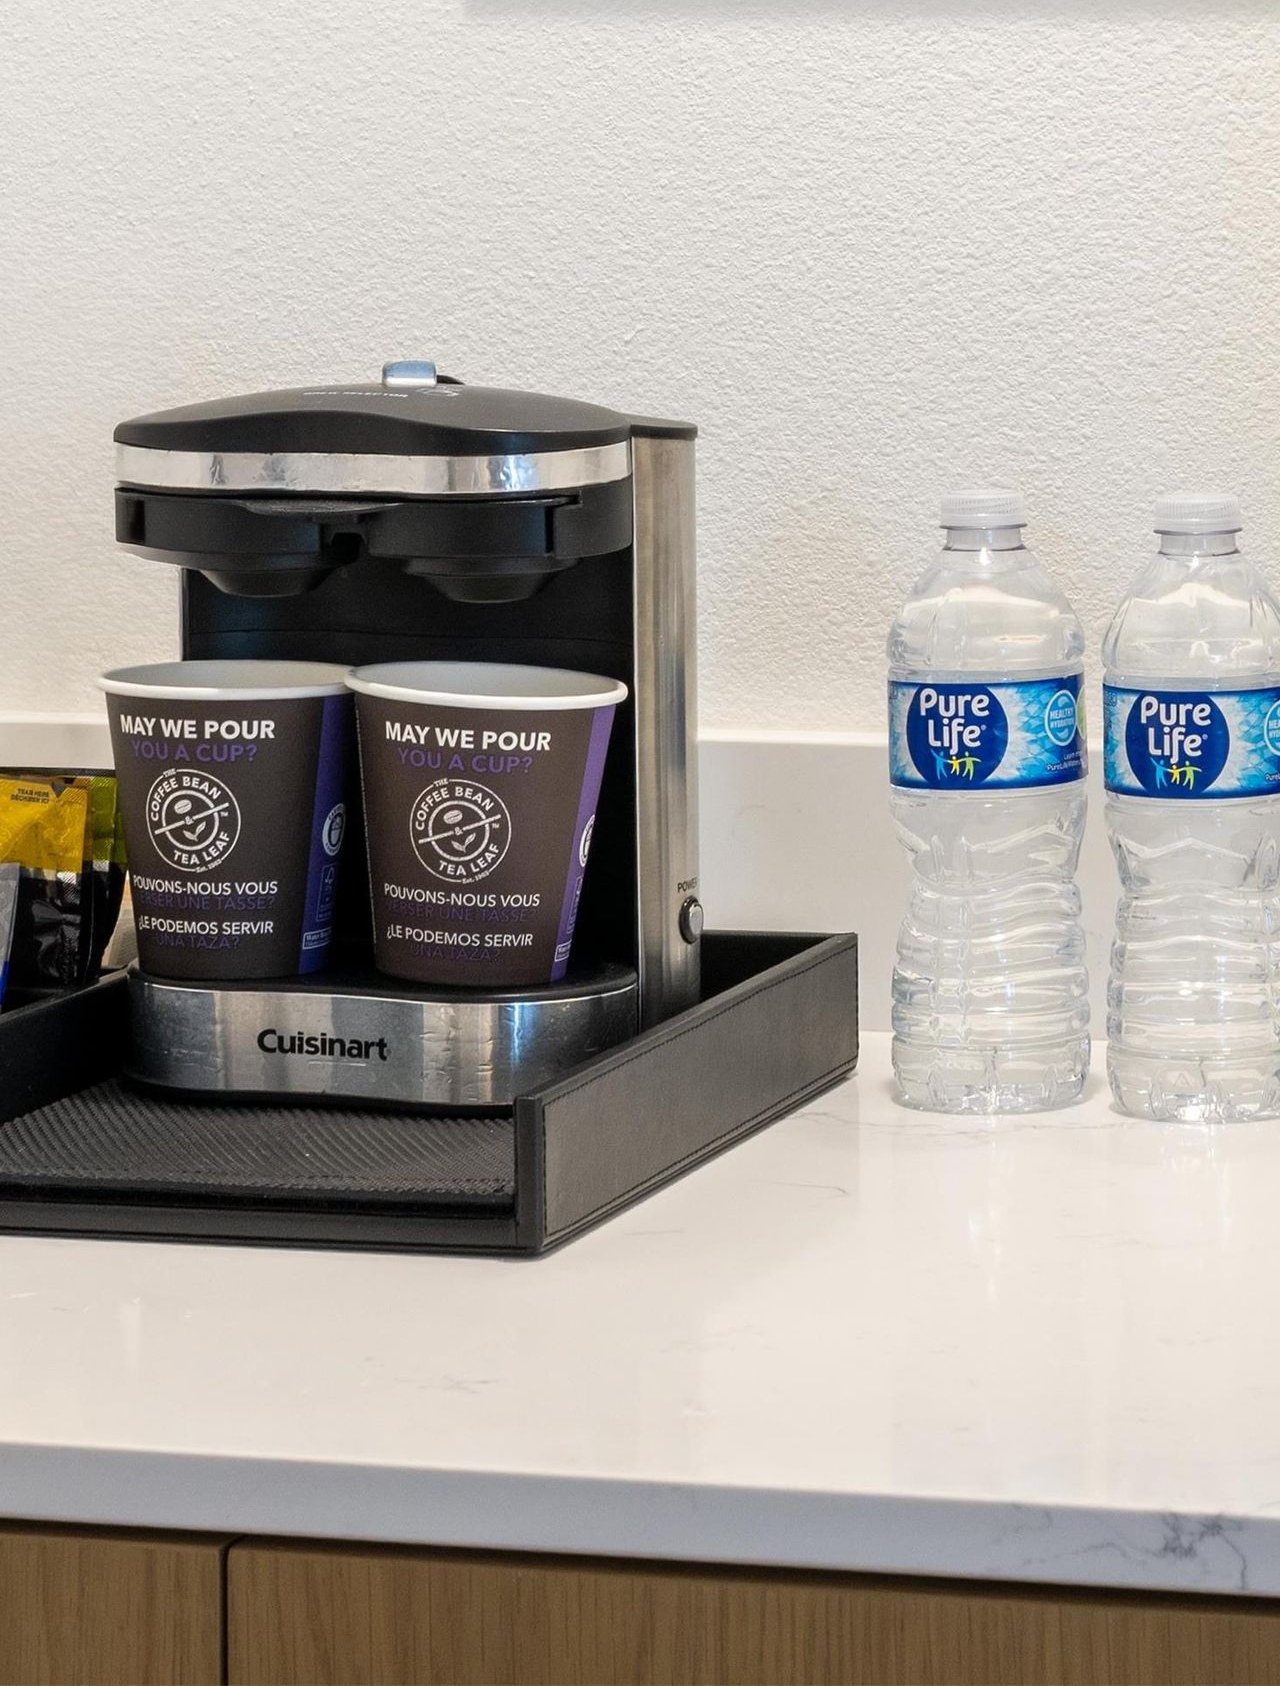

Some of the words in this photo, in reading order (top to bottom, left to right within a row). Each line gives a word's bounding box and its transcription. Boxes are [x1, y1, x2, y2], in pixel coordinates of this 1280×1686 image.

[920, 688, 990, 717] Pure
[1140, 696, 1212, 726] Pure
[120, 714, 156, 737] MAY
[160, 718, 198, 739] WE
[204, 720, 275, 740] POUR
[385, 721, 430, 745] MAY
[435, 727, 474, 749] WE
[482, 730, 551, 751] POUR
[928, 718, 982, 755] Life
[131, 739, 168, 760] YOU
[175, 744, 190, 761] A
[196, 744, 257, 762] CUP?
[1148, 726, 1202, 764] Life
[398, 747, 441, 769] YOU
[448, 753, 465, 771] A
[472, 755, 533, 773] CUP?
[433, 778, 449, 787] THE
[150, 777, 179, 821] COFFEE
[182, 776, 222, 799] BEAN
[415, 787, 450, 830] COFFEE
[454, 786, 494, 811] BEAN
[184, 816, 194, 825] &
[454, 826, 464, 836] &
[173, 850, 200, 865] TEA
[202, 831, 231, 862] LEAF
[438, 860, 467, 876] TEA
[470, 843, 500, 873] LEAF
[133, 875, 231, 895] POUVONS-NOUS
[235, 881, 278, 895] VOUS
[384, 883, 496, 907] POUVONS-NOUS
[500, 893, 541, 907] VOUS
[177, 895, 212, 910] UNE
[218, 896, 276, 911] TASSE?
[439, 906, 474, 921] UNE
[152, 918, 218, 935] PODEMOS
[222, 921, 274, 935] SERVIR
[387, 924, 403, 939] ¿LE
[405, 928, 480, 946] PODEMOS
[484, 934, 534, 947] SERVIR
[188, 935, 240, 950] TAZA?
[257, 1028, 388, 1061] Cuisinart
